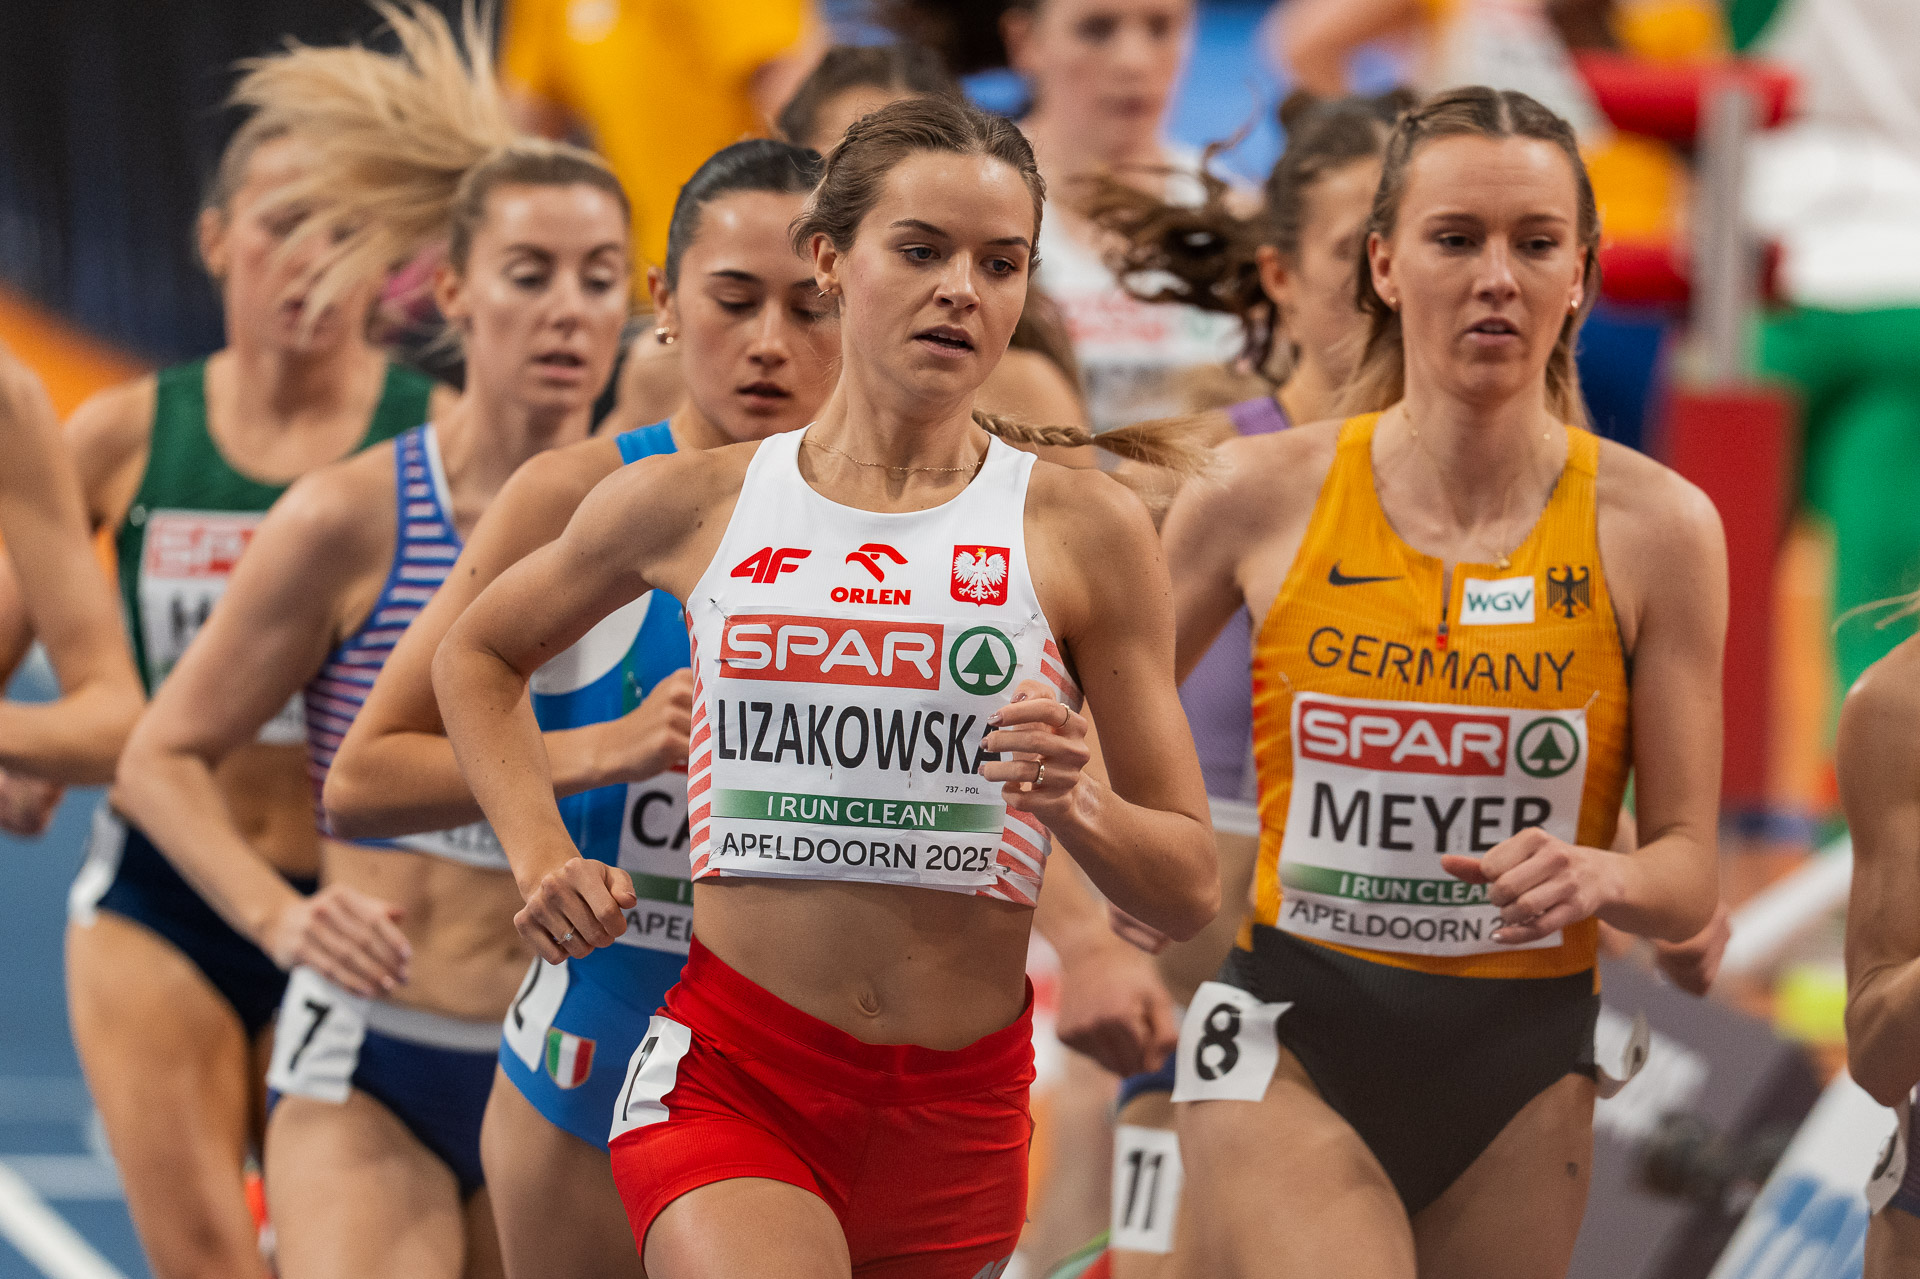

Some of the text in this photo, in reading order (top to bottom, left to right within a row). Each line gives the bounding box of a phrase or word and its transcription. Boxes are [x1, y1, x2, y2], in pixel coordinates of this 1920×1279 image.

[730, 546, 812, 584] 4F
[830, 586, 912, 606] ORLEN
[1466, 588, 1532, 612] WGV
[727, 623, 937, 680] SPAR
[1307, 626, 1575, 692] GERMANY
[1302, 708, 1504, 768] SPAR
[767, 795, 774, 817] I
[780, 796, 839, 821] RUN
[945, 785, 959, 793] 737
[965, 787, 980, 795] POL
[1309, 781, 1553, 853] MEYER
[719, 832, 993, 872] APELDOORN 2025
[1339, 873, 1490, 904] I RUN CLEA
[1289, 899, 1482, 942] APELDOORN
[287, 998, 332, 1073] 7
[1195, 1002, 1241, 1082] 8
[1124, 1149, 1163, 1232] 11
